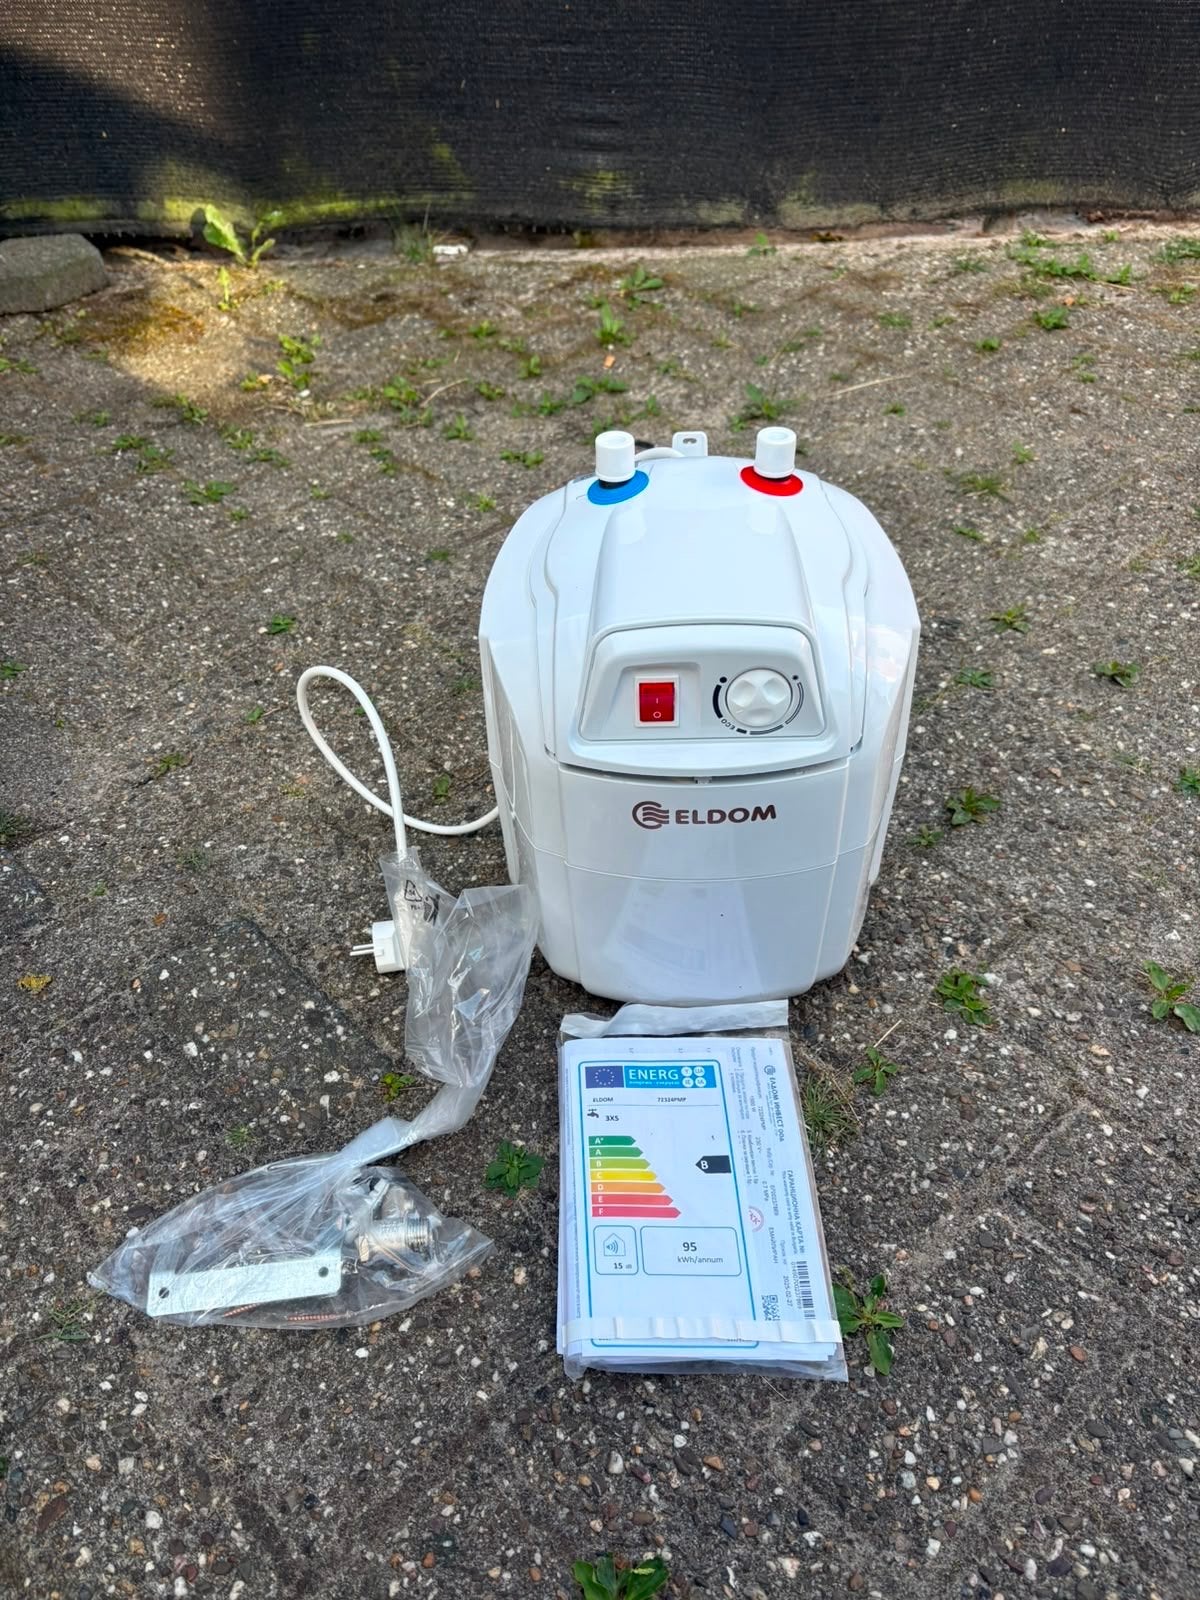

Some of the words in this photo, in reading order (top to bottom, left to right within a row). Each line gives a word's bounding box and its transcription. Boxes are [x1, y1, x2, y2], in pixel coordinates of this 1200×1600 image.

[720, 718, 736, 730] ECO
[675, 805, 777, 825] ELDOM
[628, 1069, 679, 1080] ENERG
[700, 1160, 709, 1169] B
[598, 1195, 604, 1203] E
[598, 1207, 604, 1215] F
[682, 1241, 697, 1252] 95
[677, 1255, 723, 1265] kWh/annum
[613, 1262, 623, 1270] 15
[783, 1275, 793, 1307] 2025-02-27
